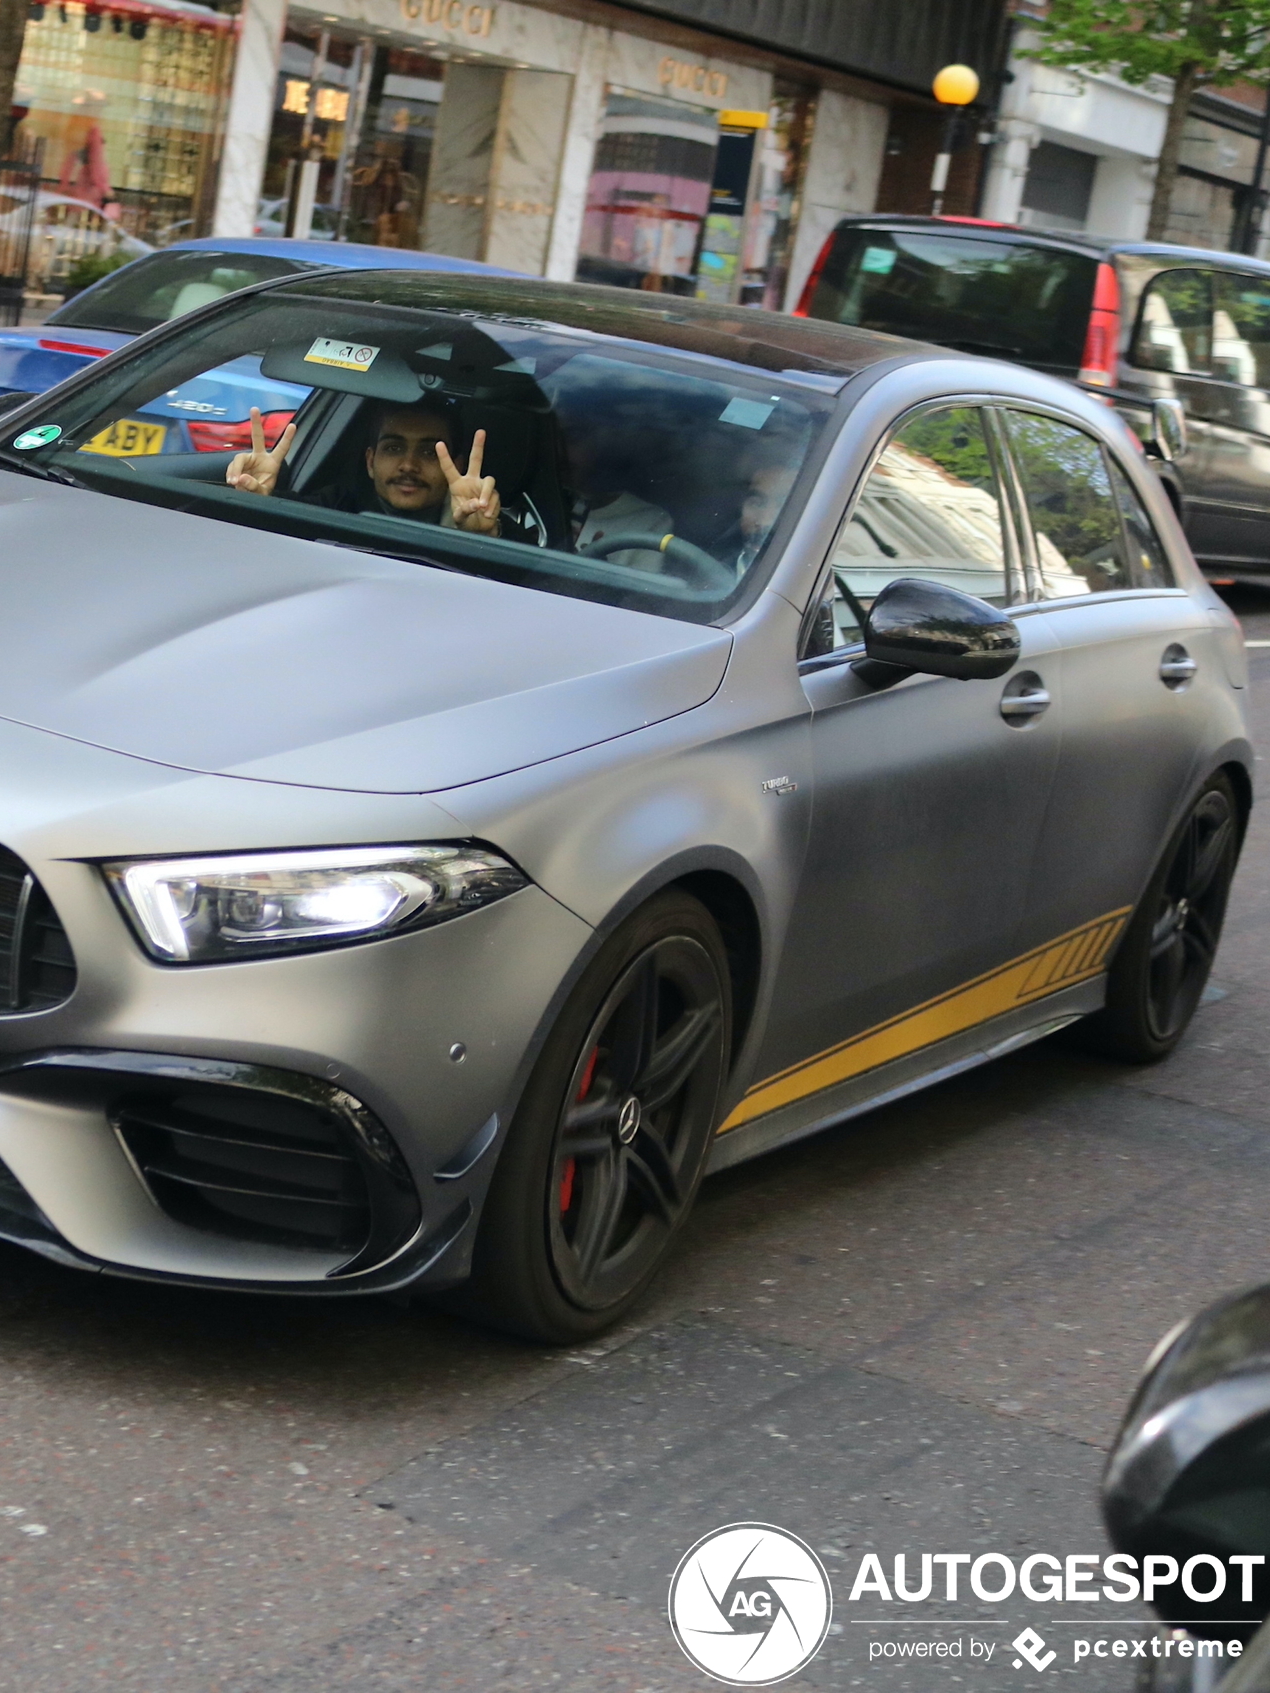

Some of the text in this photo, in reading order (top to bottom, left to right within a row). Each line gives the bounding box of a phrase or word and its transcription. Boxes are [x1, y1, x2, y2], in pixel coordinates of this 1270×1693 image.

[399, 0, 493, 37] GUCCI
[658, 56, 729, 98] GUCCI
[106, 423, 159, 453] ABY
[761, 776, 789, 791] TURBO
